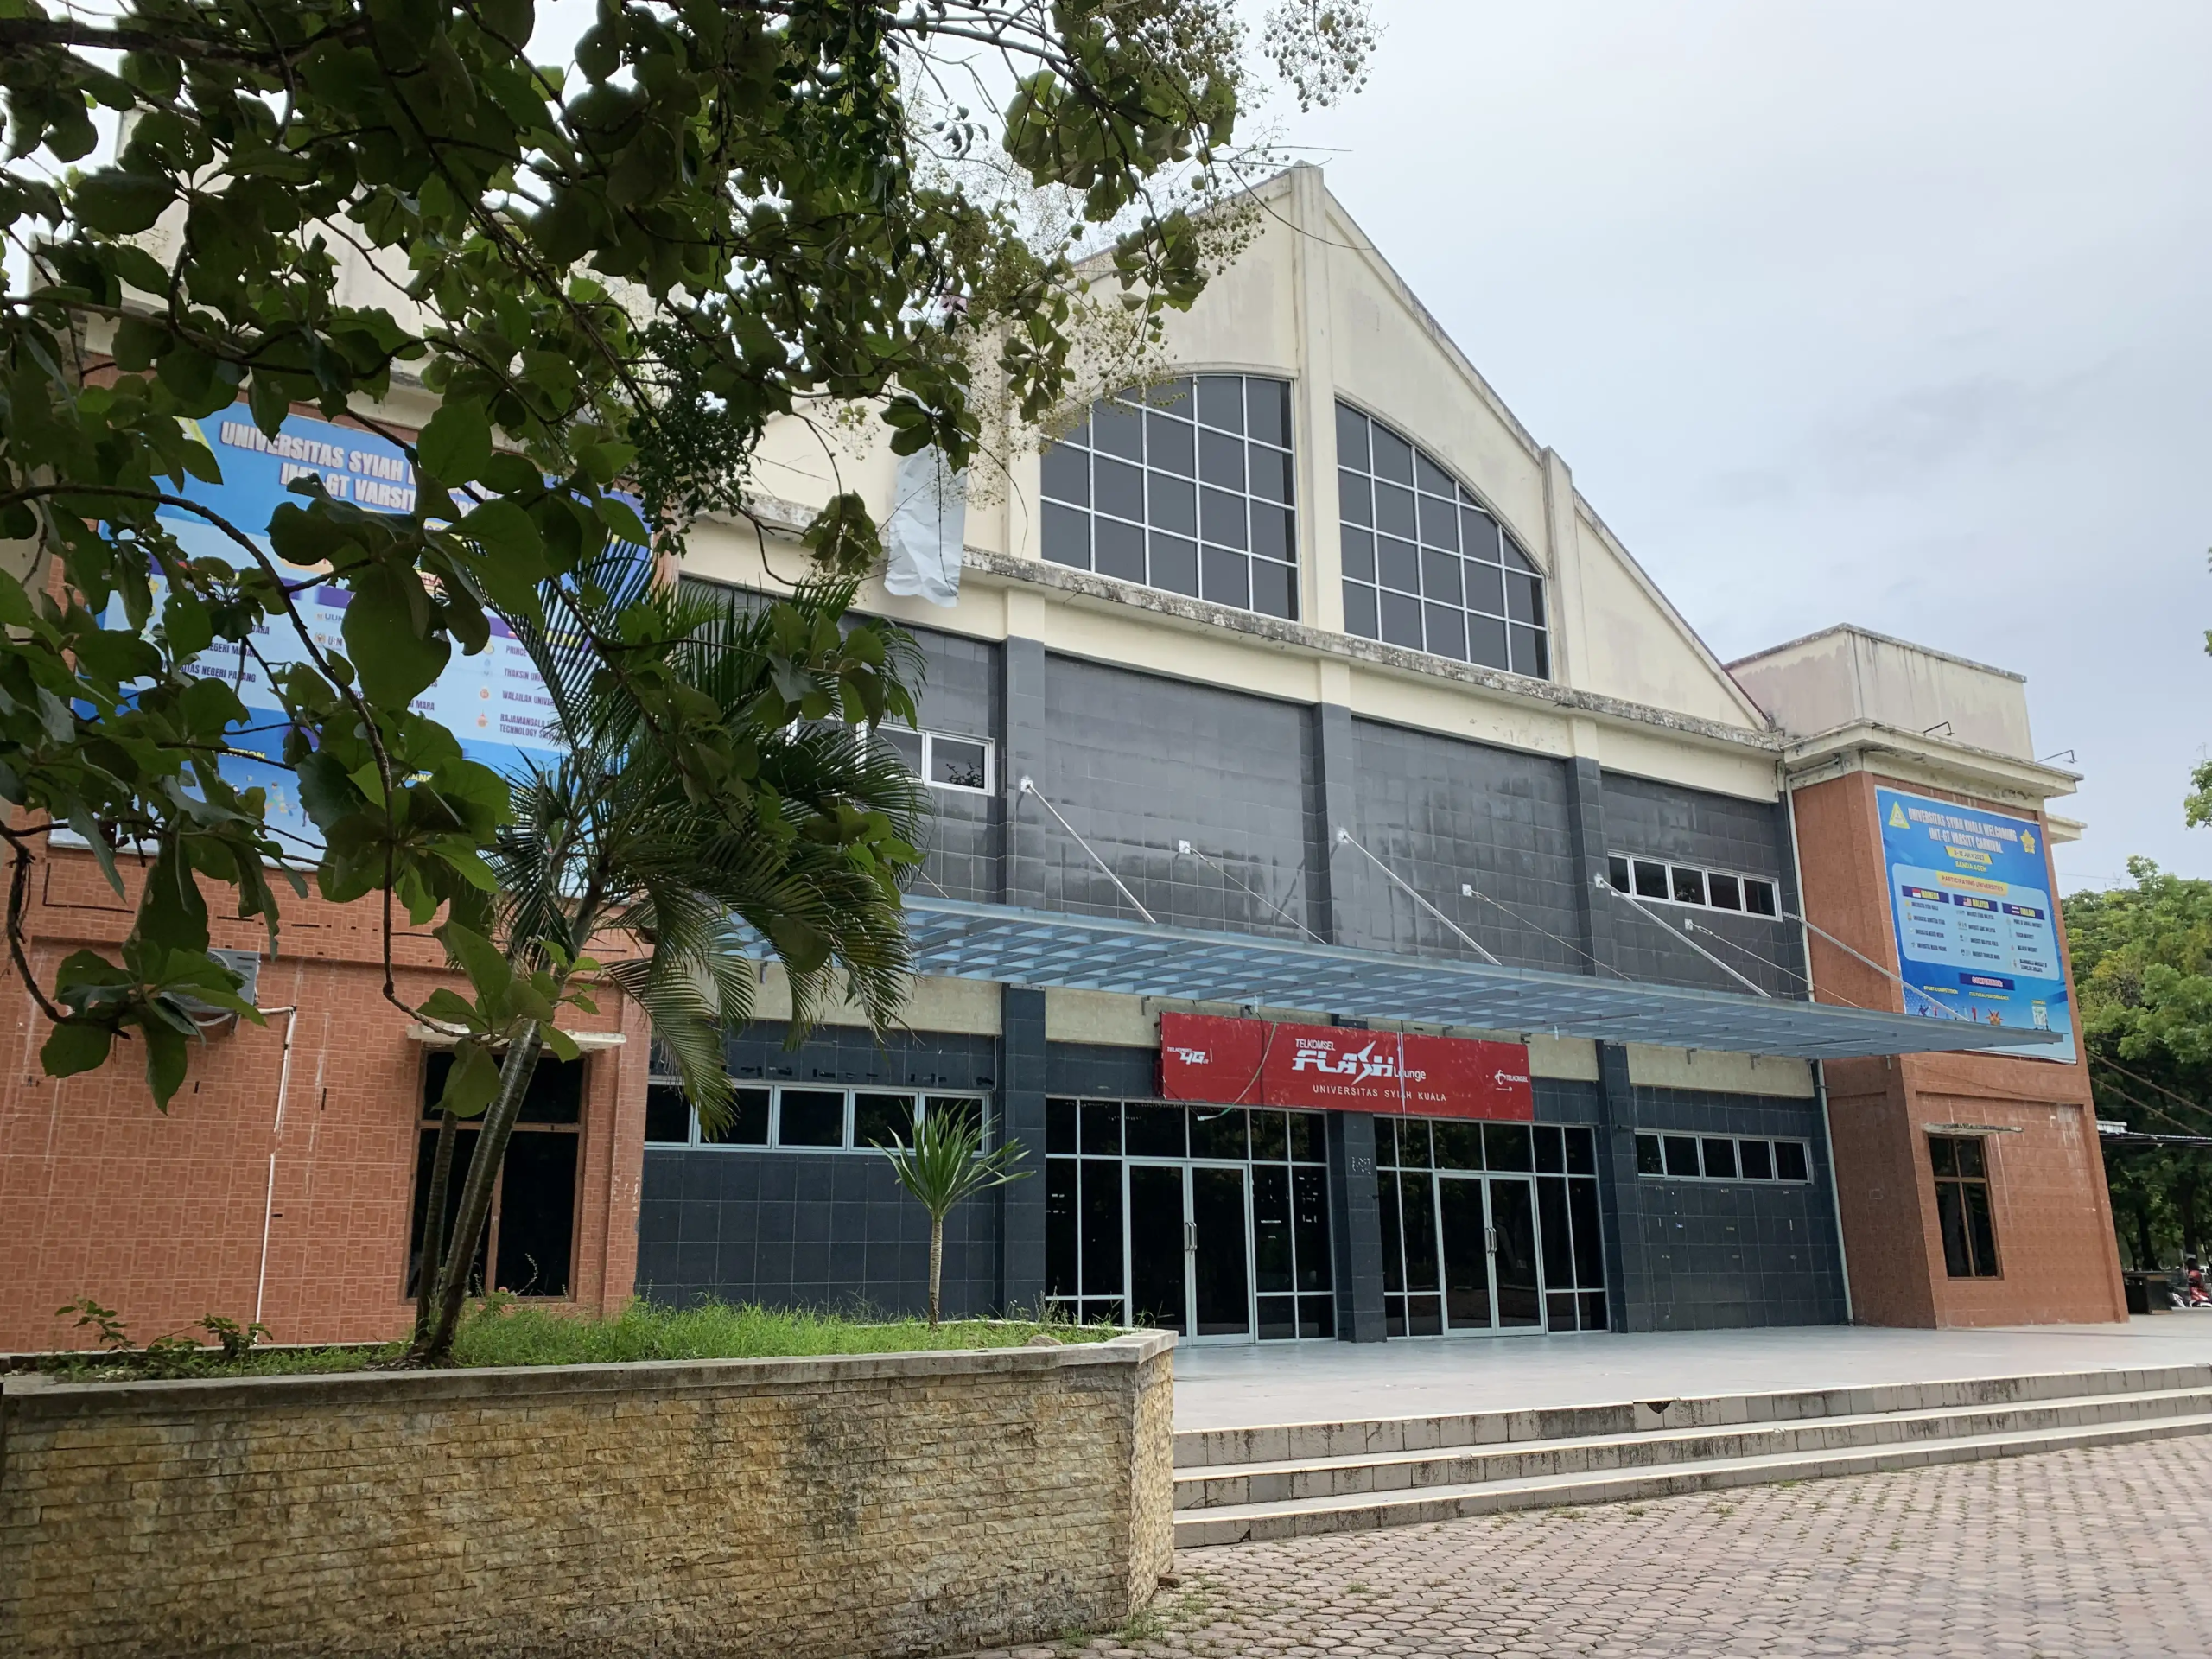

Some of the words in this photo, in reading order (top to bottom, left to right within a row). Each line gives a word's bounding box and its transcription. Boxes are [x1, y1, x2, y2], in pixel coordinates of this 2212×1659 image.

[220, 421, 345, 468] UNIVERSITAS
[347, 450, 404, 482] SYIAH
[353, 478, 417, 512] VARSIT
[201, 665, 226, 677] NEGERI
[227, 670, 257, 683] PAANG
[415, 699, 435, 711] MARA
[499, 713, 545, 728] RAJAMANGALA
[499, 724, 537, 737] TECHNOLOGY
[1294, 1038, 1336, 1051] TELKOMSEL
[1179, 1050, 1206, 1065] 4G
[1291, 1040, 1395, 1085] FLASH
[1313, 1084, 1378, 1097] UNIVERSITAS
[1417, 1091, 1447, 1102] KUALA
